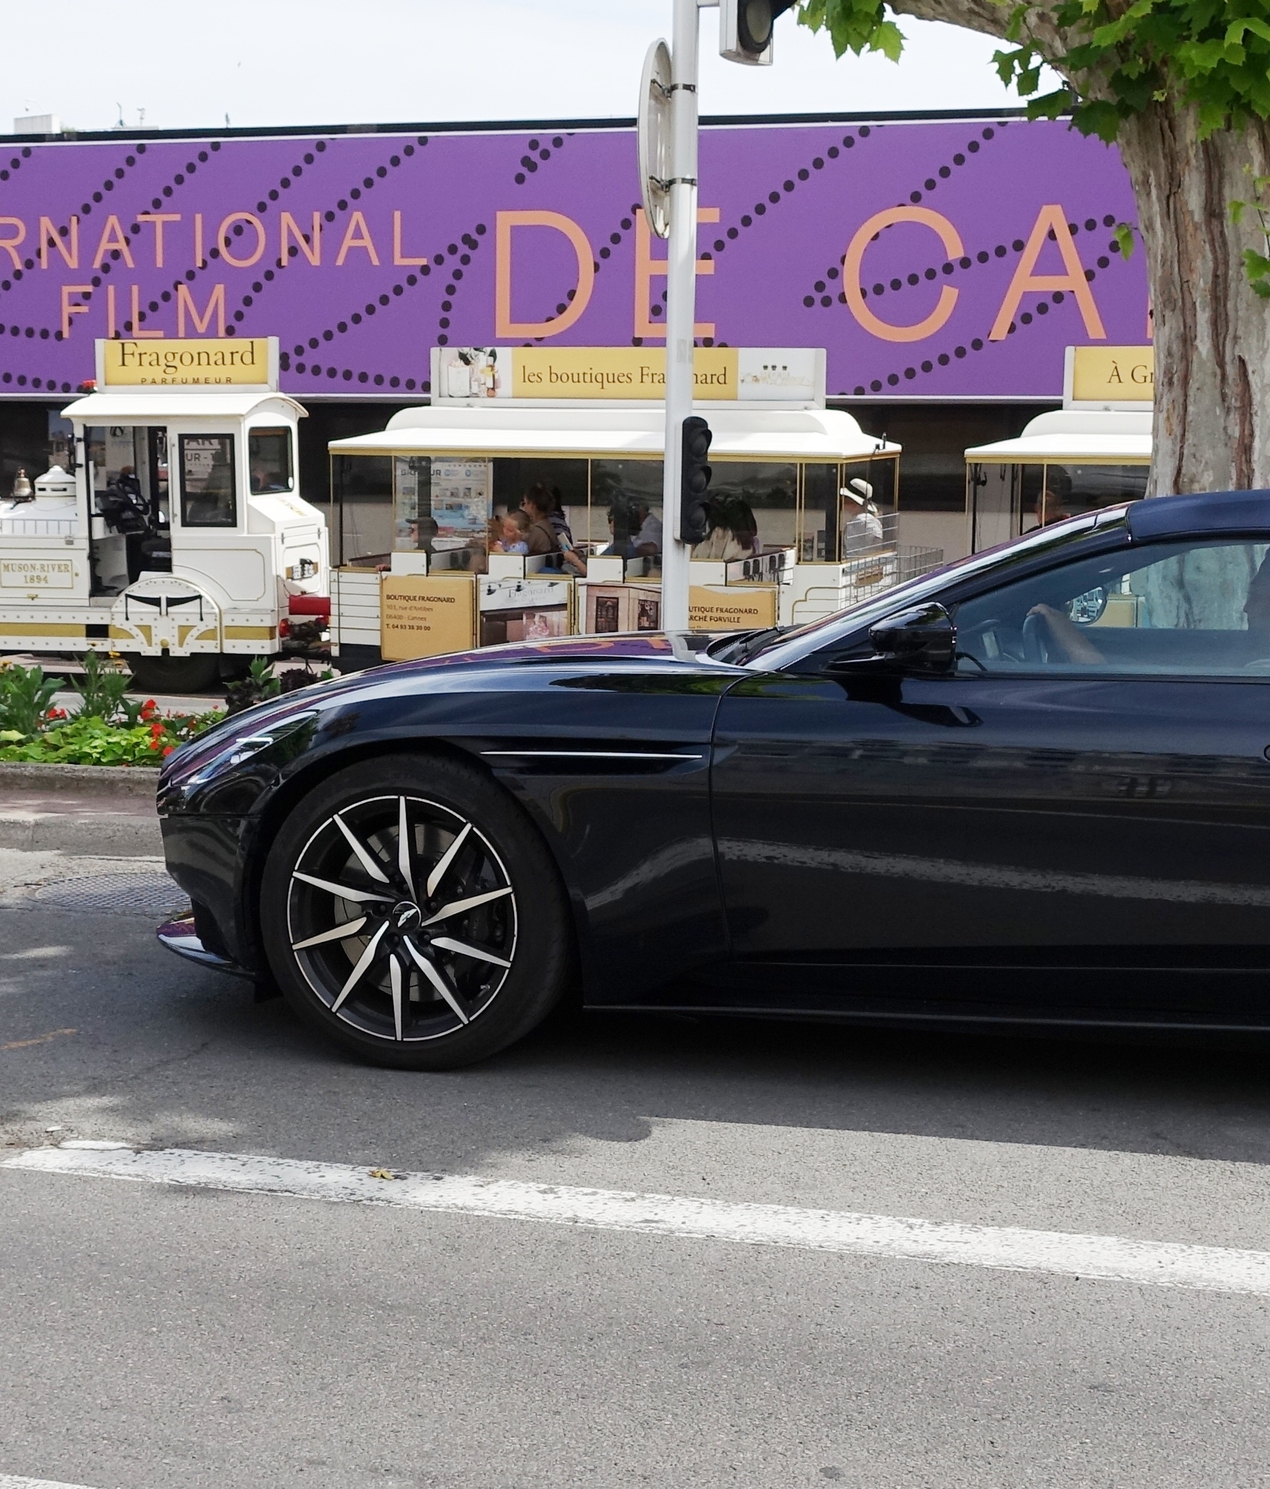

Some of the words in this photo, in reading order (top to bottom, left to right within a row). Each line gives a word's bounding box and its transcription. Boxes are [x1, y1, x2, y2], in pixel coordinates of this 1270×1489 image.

[495, 207, 720, 339] DE
[61, 283, 226, 339] FILM
[118, 341, 256, 375] Fragonard
[522, 365, 543, 384] les
[549, 366, 632, 389] boutiques
[639, 366, 727, 385] Franard
[1106, 360, 1124, 383] À
[3, 563, 70, 573] MUSON-RIVER
[24, 574, 48, 584] 1894
[386, 594, 417, 602] BOUTIQUE
[418, 595, 456, 603] FRAGONARD
